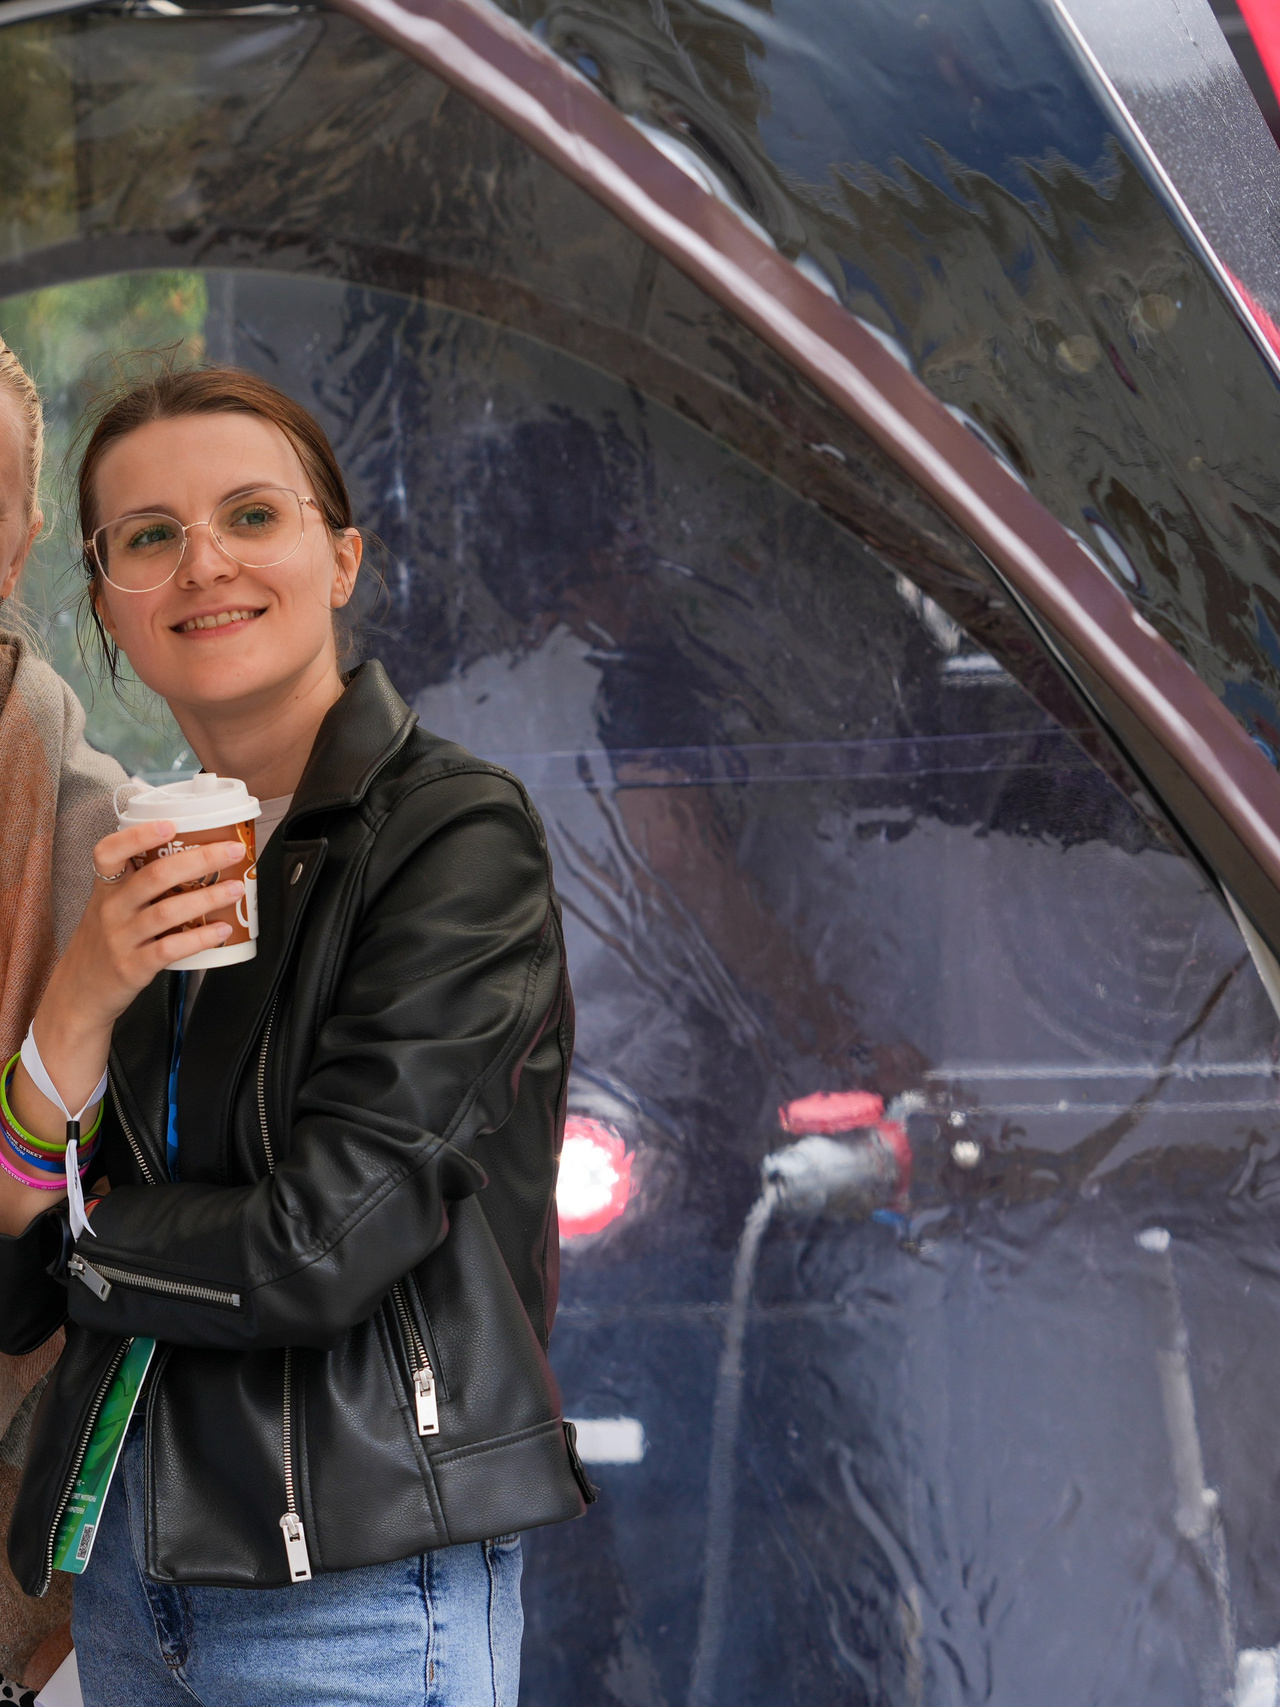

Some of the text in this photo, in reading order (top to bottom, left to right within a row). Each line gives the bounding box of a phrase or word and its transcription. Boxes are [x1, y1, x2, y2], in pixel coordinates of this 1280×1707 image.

[157, 841, 200, 858] alpr
[19, 1144, 44, 1159] STREET
[0, 1163, 31, 1186] GASTREET
